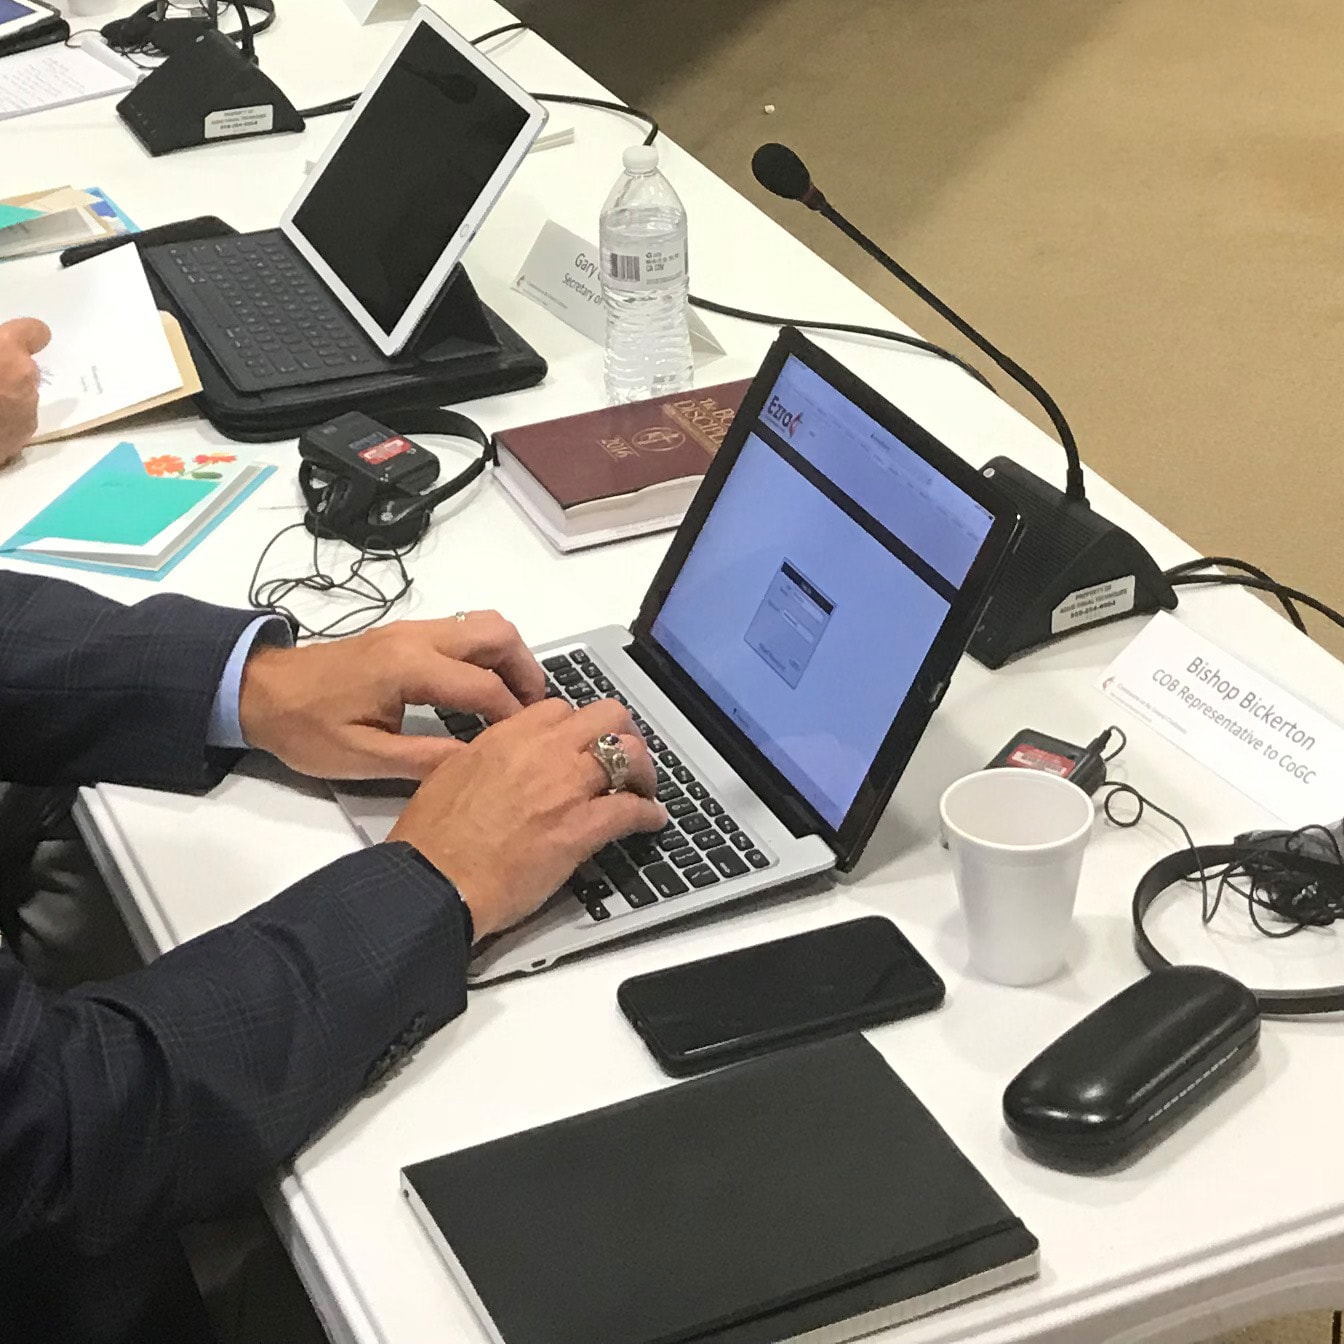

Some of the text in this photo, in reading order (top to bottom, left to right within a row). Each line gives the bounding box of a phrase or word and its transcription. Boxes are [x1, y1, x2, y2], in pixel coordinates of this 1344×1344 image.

[575, 253, 597, 278] Gary
[563, 273, 595, 302] Secretary
[601, 437, 634, 458] 2016
[1186, 656, 1240, 701] Bishop
[1239, 691, 1316, 751] Bickerton
[1152, 669, 1180, 692] COB
[1177, 685, 1264, 750] Representative
[1263, 744, 1279, 760] to
[1278, 754, 1317, 785] CoGC
